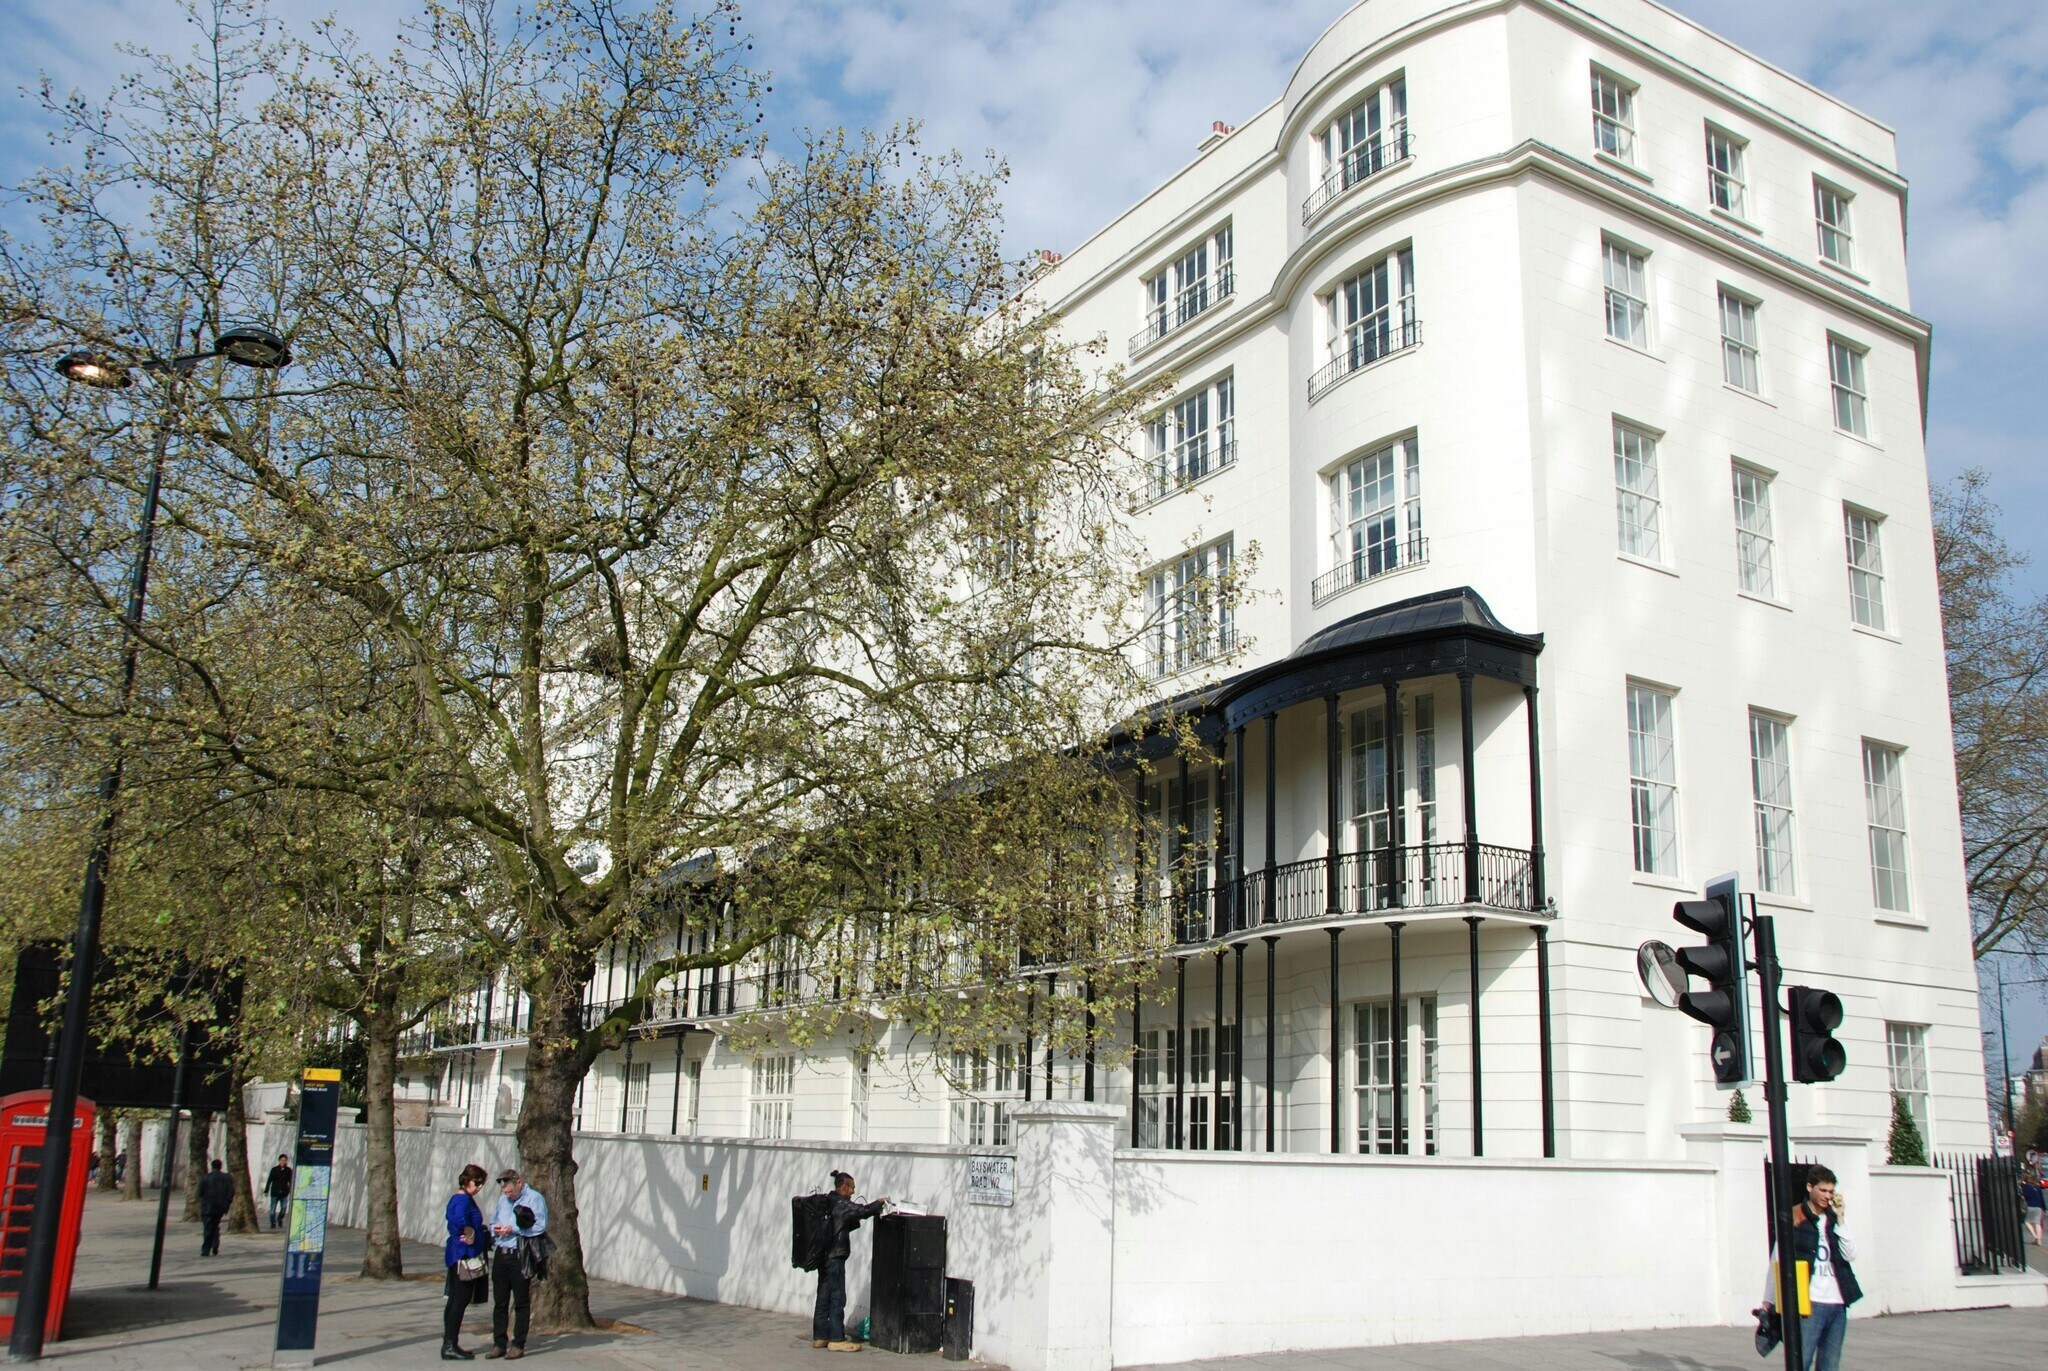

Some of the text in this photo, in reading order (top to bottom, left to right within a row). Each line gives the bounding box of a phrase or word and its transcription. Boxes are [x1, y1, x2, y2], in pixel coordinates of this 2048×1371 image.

[971, 1161, 1007, 1174] BAYSWATER
[971, 1175, 1000, 1189] ROAD W2
